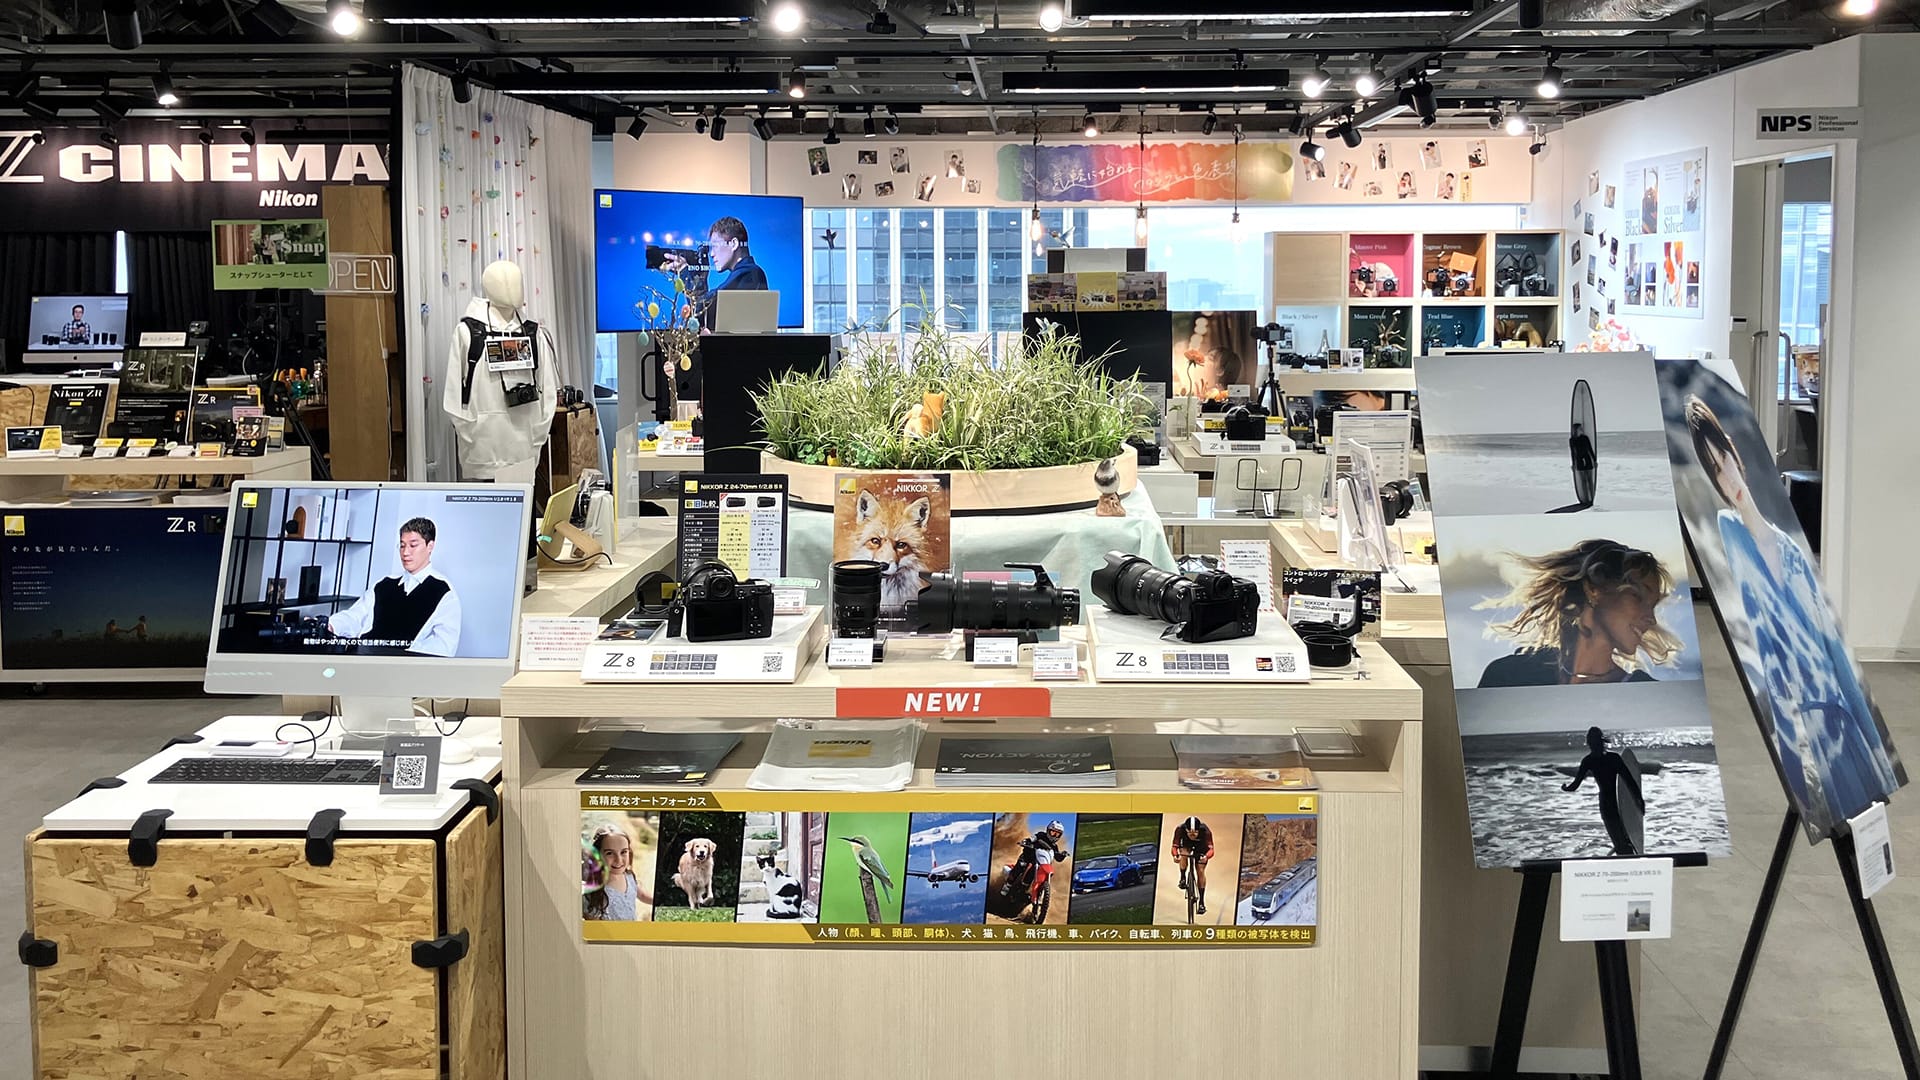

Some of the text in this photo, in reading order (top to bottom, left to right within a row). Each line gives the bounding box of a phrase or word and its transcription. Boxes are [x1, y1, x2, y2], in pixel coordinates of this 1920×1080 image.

[1761, 115, 1812, 132] NPS
[59, 143, 390, 183] CINEMA
[259, 189, 318, 207] Nikon
[281, 238, 325, 262] Snap
[329, 259, 391, 291] PEN
[53, 389, 103, 398] Nikon ZR
[896, 484, 928, 493] NIKKOR
[187, 520, 197, 532] R
[626, 656, 636, 668] 8
[1138, 655, 1148, 667] 8
[904, 692, 982, 712] NEW!
[588, 795, 707, 807] 高精度なオートフォーカス
